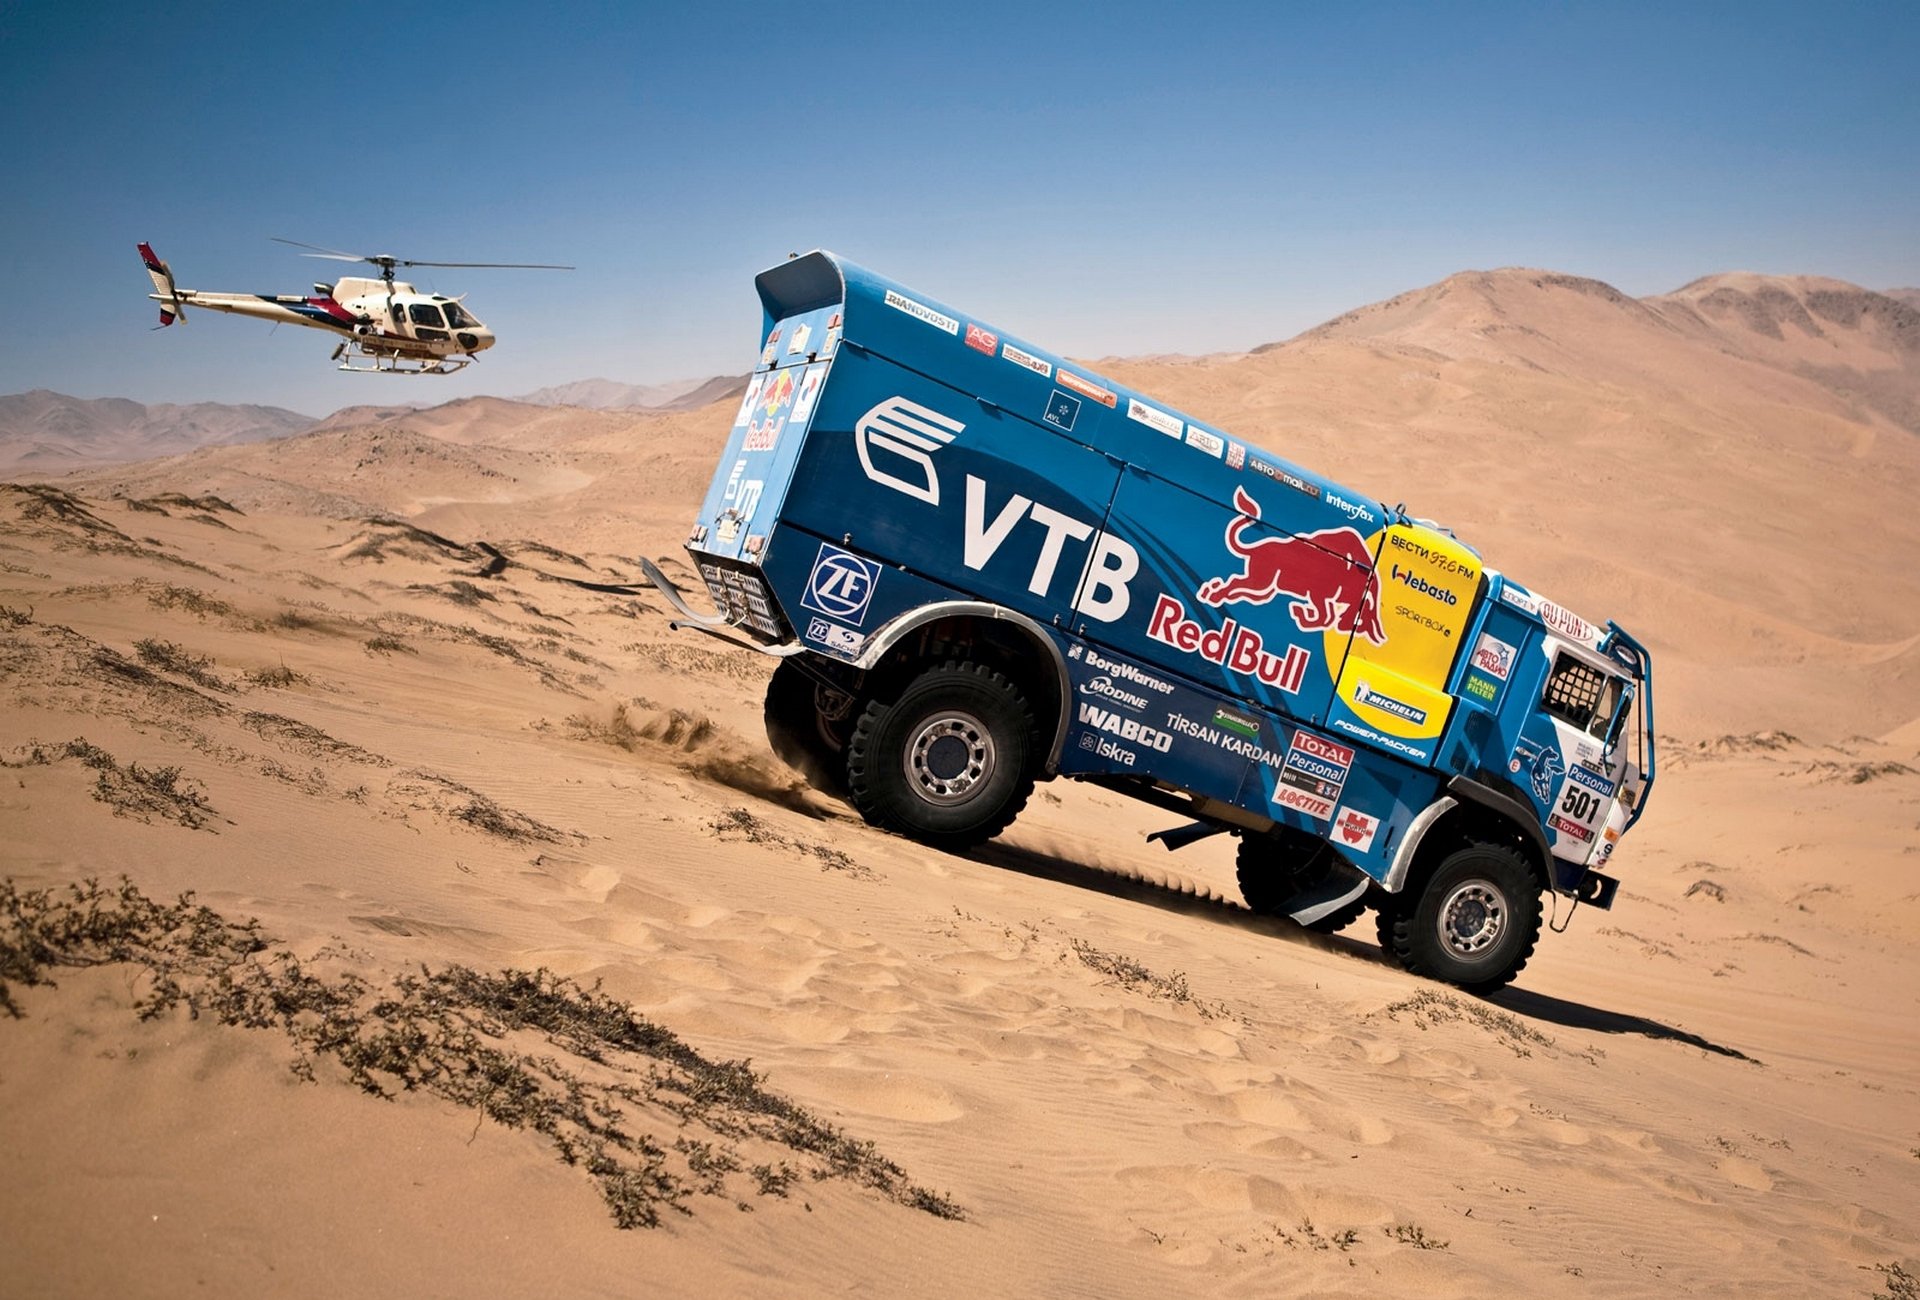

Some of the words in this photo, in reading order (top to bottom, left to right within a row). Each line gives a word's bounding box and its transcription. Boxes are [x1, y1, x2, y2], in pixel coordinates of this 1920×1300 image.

[968, 326, 997, 350] AG
[1046, 412, 1061, 425] AVL
[1325, 491, 1375, 523] interfax
[963, 473, 1140, 623] VTB
[1391, 534, 1429, 559] ВЕСТИ
[1429, 551, 1457, 573] 97.6
[1457, 564, 1475, 580] FM
[816, 560, 870, 608] ZF
[1391, 563, 1457, 606] Webasto
[830, 640, 858, 655] SACHS
[1476, 648, 1500, 664] АВТО
[1085, 650, 1175, 695] BorgWarner
[1479, 658, 1508, 678] РАДИО
[1089, 680, 1149, 709] MODINE
[1466, 683, 1495, 701] FILTER
[1469, 675, 1497, 693] MANN
[1369, 693, 1425, 722] MICHELIN
[1078, 702, 1174, 754] WABCO
[1334, 718, 1428, 760] POWER-PACKER
[1095, 737, 1137, 766] Iskra
[1220, 734, 1283, 769] KARDAN
[1298, 732, 1349, 765] TOTAL
[1288, 751, 1345, 783] Personal
[1568, 766, 1614, 796] Personal
[1276, 788, 1331, 816] LOCTITE
[1561, 784, 1602, 825] 501
[1559, 819, 1585, 838] TOTAL
